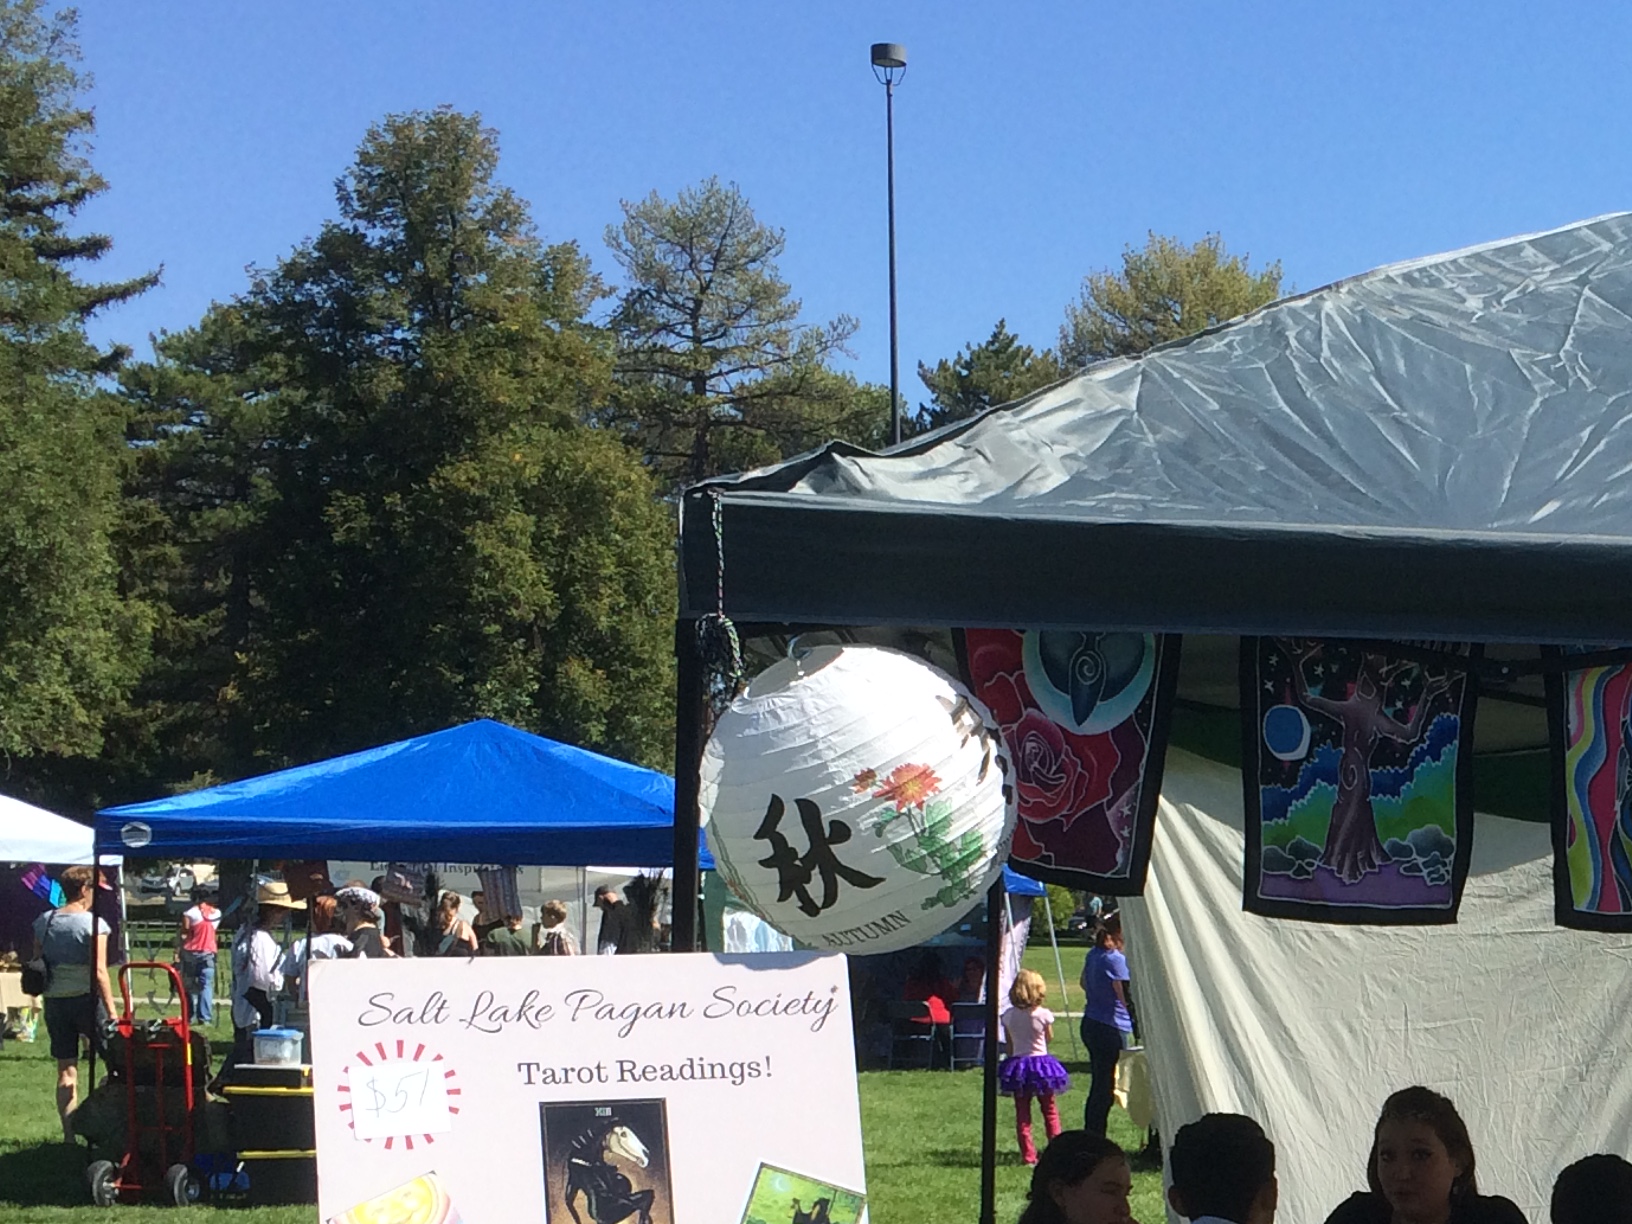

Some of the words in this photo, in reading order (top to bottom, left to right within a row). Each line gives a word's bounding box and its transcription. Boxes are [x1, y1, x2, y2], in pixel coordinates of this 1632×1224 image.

[753, 793, 887, 918] 秋
[821, 910, 912, 947] AUTUMN
[358, 991, 450, 1026] Salt
[460, 990, 555, 1033] Lake
[564, 989, 694, 1038] Pagan
[703, 985, 838, 1032] Society
[517, 1061, 608, 1086] Tarot
[615, 1055, 773, 1087] Readings!
